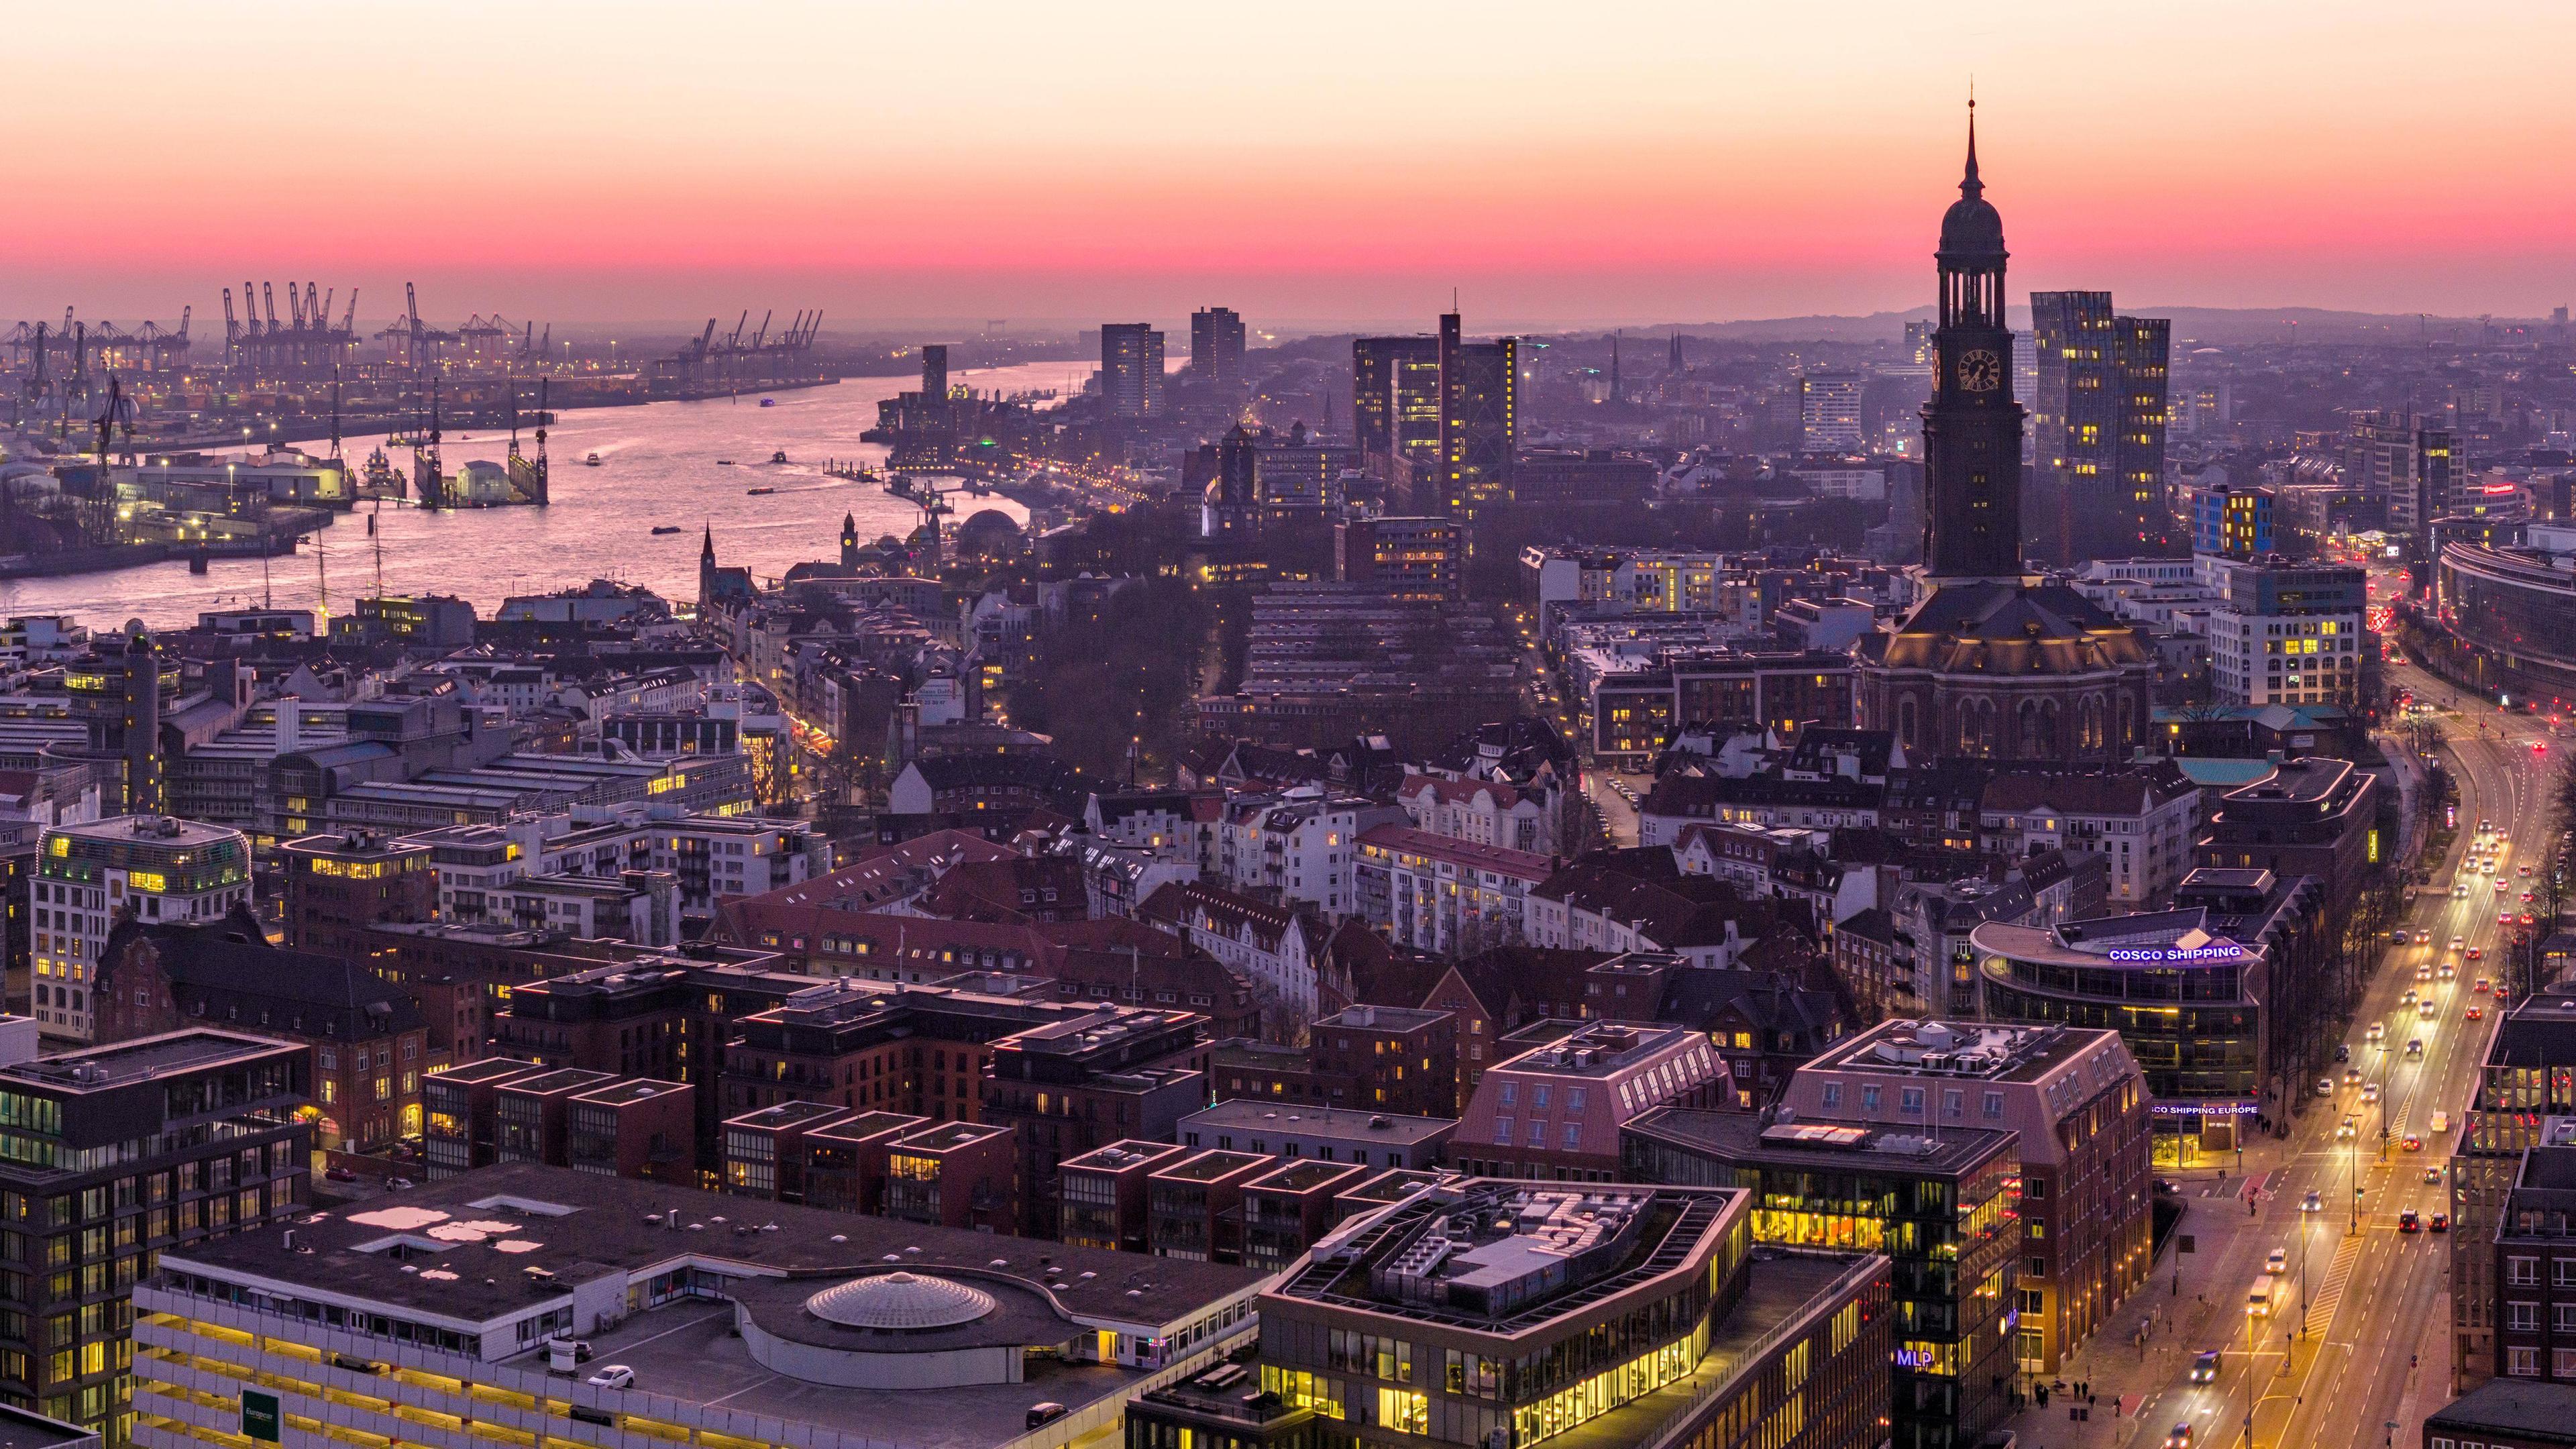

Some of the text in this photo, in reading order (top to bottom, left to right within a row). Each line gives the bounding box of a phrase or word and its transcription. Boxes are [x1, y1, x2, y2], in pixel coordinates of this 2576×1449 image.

[2109, 947, 2241, 961] COSCO SHIPPING
[2006, 1307, 2018, 1330] MLP
[1897, 1350, 1933, 1367] MLP
[246, 1407, 273, 1419] Europcar
